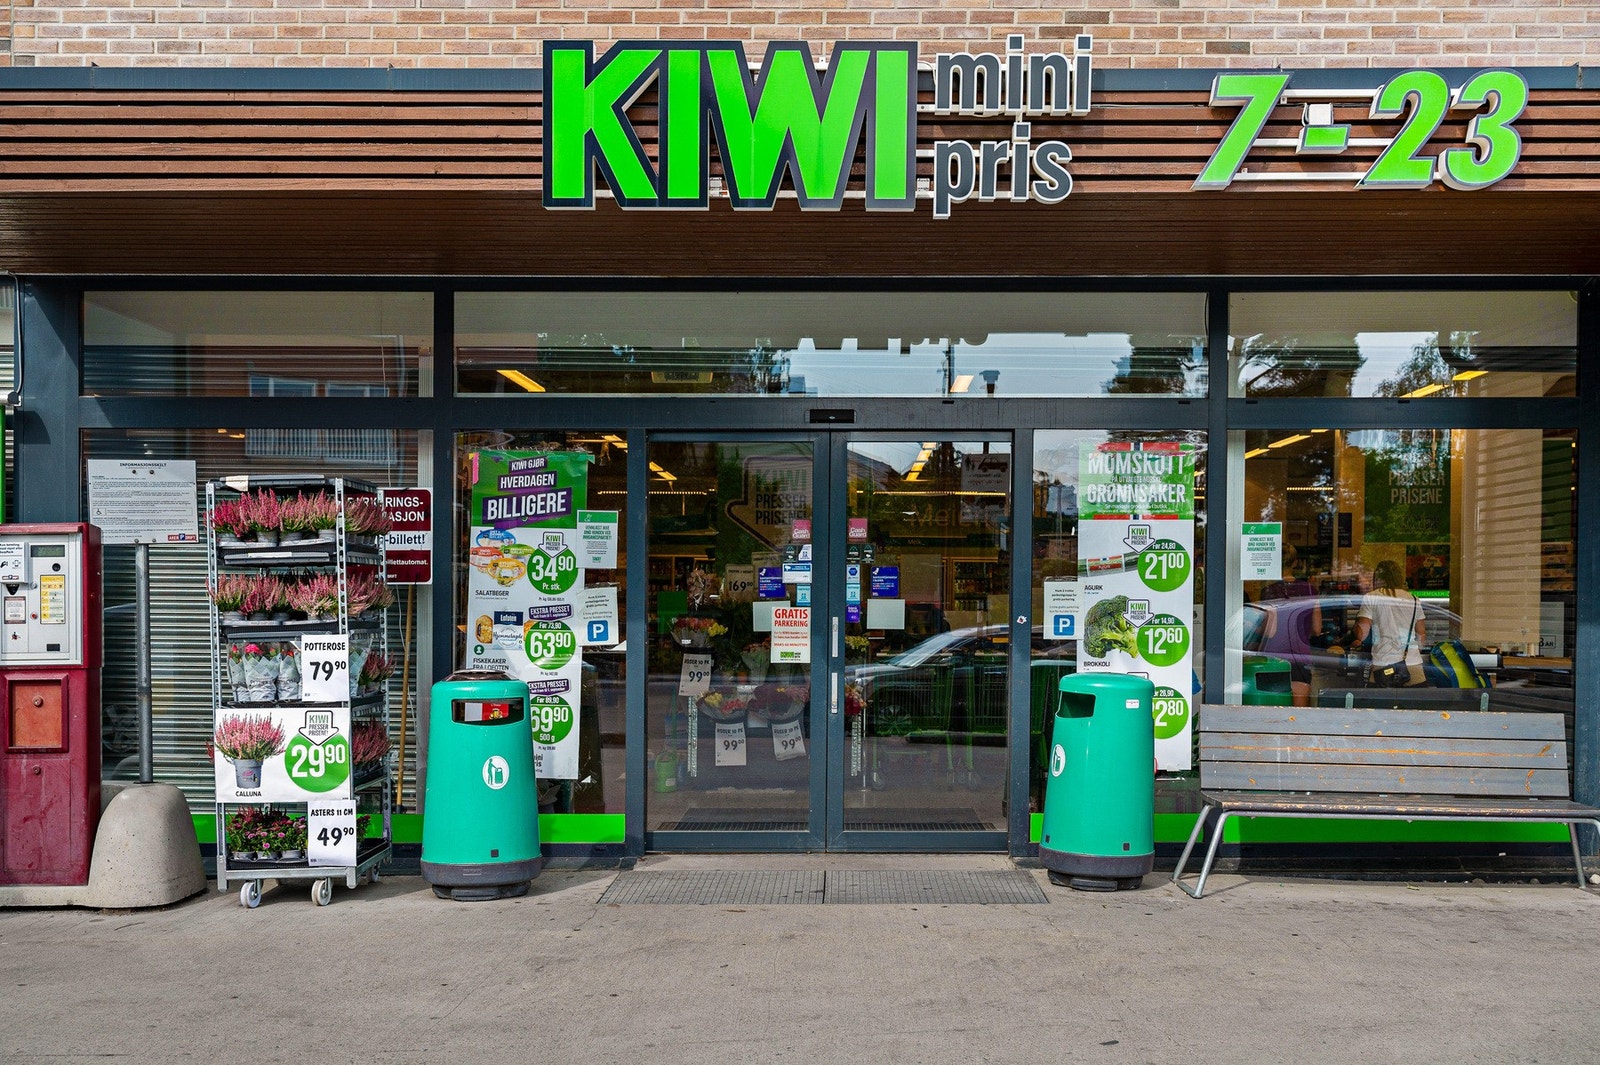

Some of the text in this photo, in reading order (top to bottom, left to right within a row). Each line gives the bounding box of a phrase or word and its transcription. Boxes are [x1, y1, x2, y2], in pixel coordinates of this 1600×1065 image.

[935, 34, 1093, 115] mini
[543, 40, 918, 211] KIWI
[933, 122, 1074, 219] pris
[511, 458, 544, 471] KIWI GJØR
[500, 473, 555, 489] HVERDAGEN
[1087, 484, 1186, 502] GRØNNSAKER
[1391, 488, 1442, 504] PRISENE
[487, 491, 567, 520] BILLIGERE
[755, 494, 806, 508] PRESSER
[774, 608, 808, 619] GRATIS
[592, 624, 605, 639] P
[1059, 618, 1070, 633] P
[304, 642, 346, 651] POTTEROSE
[547, 680, 567, 688] PRESSET
[309, 715, 328, 723] KIWI
